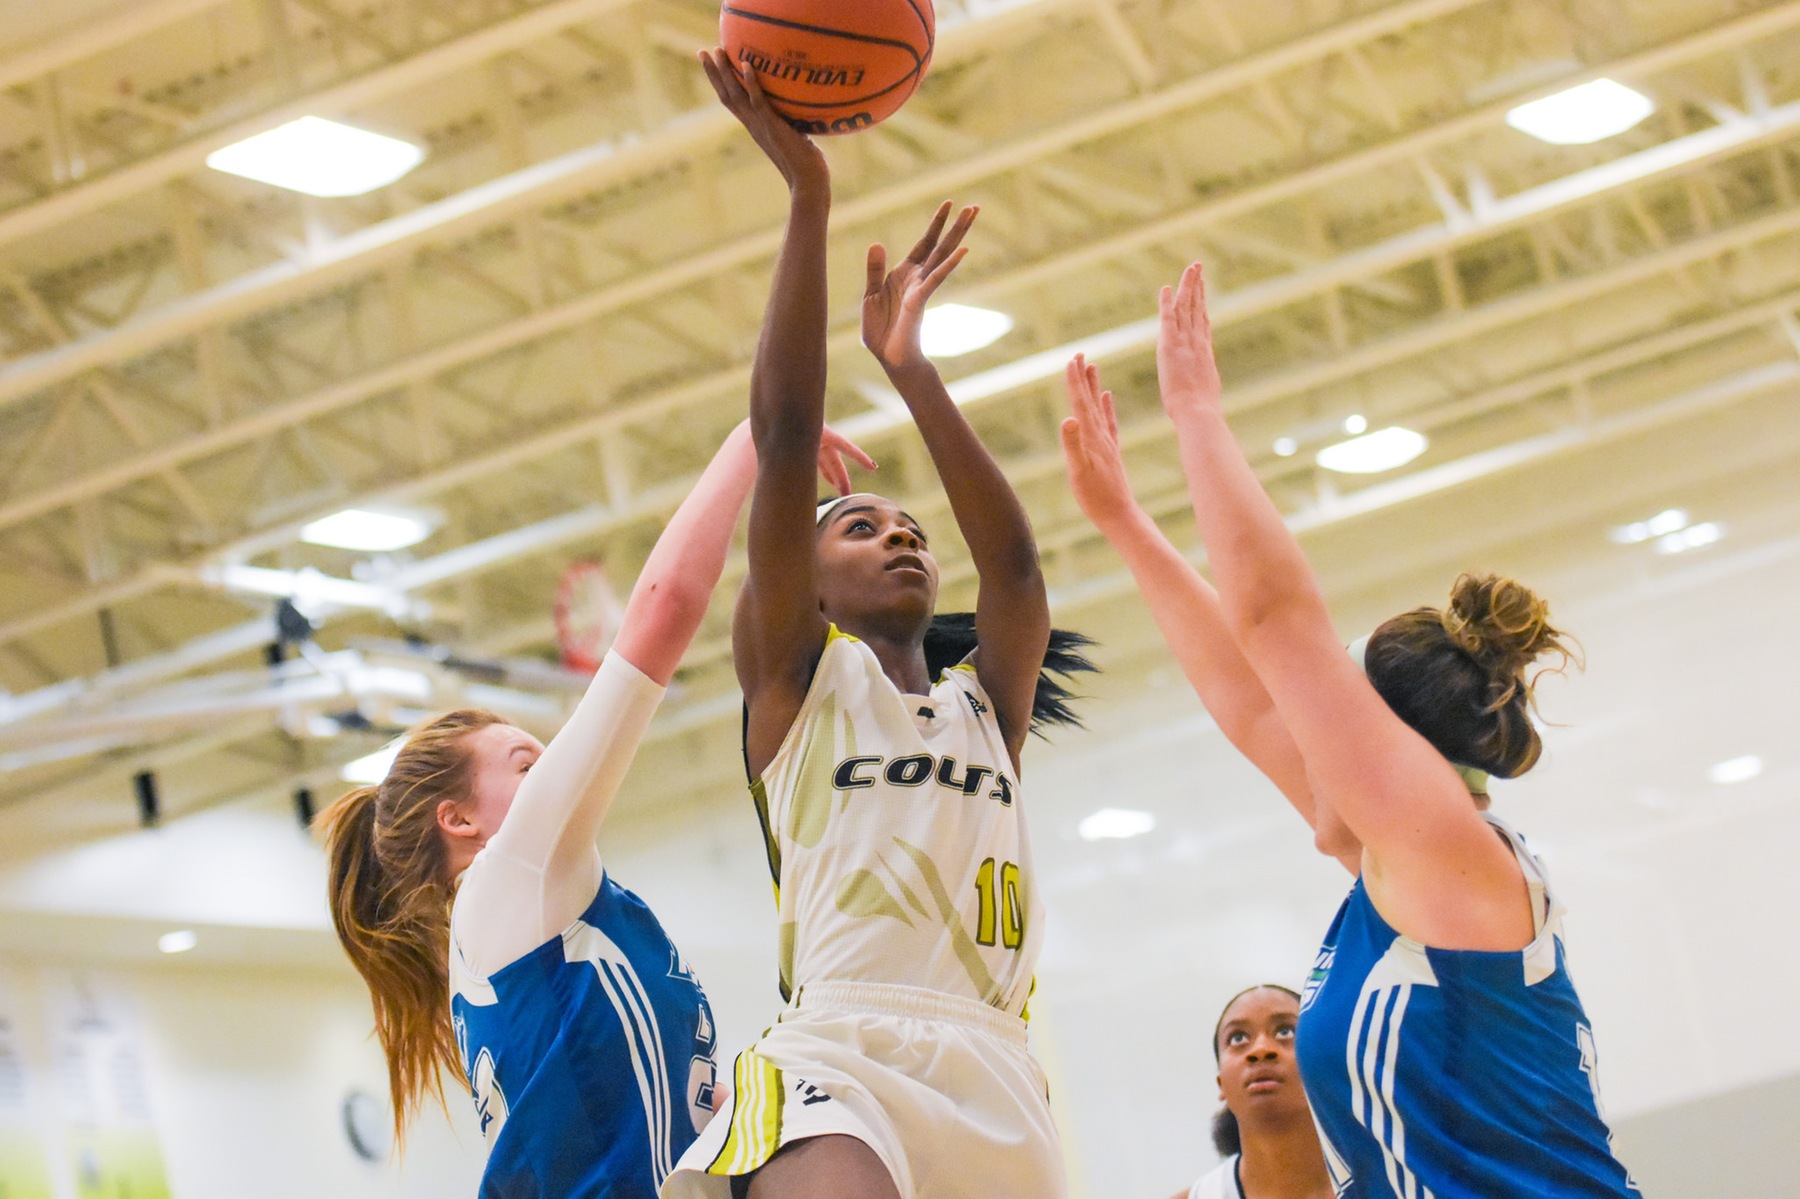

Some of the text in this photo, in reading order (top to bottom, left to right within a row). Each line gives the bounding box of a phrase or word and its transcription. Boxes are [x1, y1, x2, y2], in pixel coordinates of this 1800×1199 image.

[737, 47, 865, 87] EVOLUTION
[832, 753, 1012, 807] COLTS
[975, 857, 1023, 951] 10
